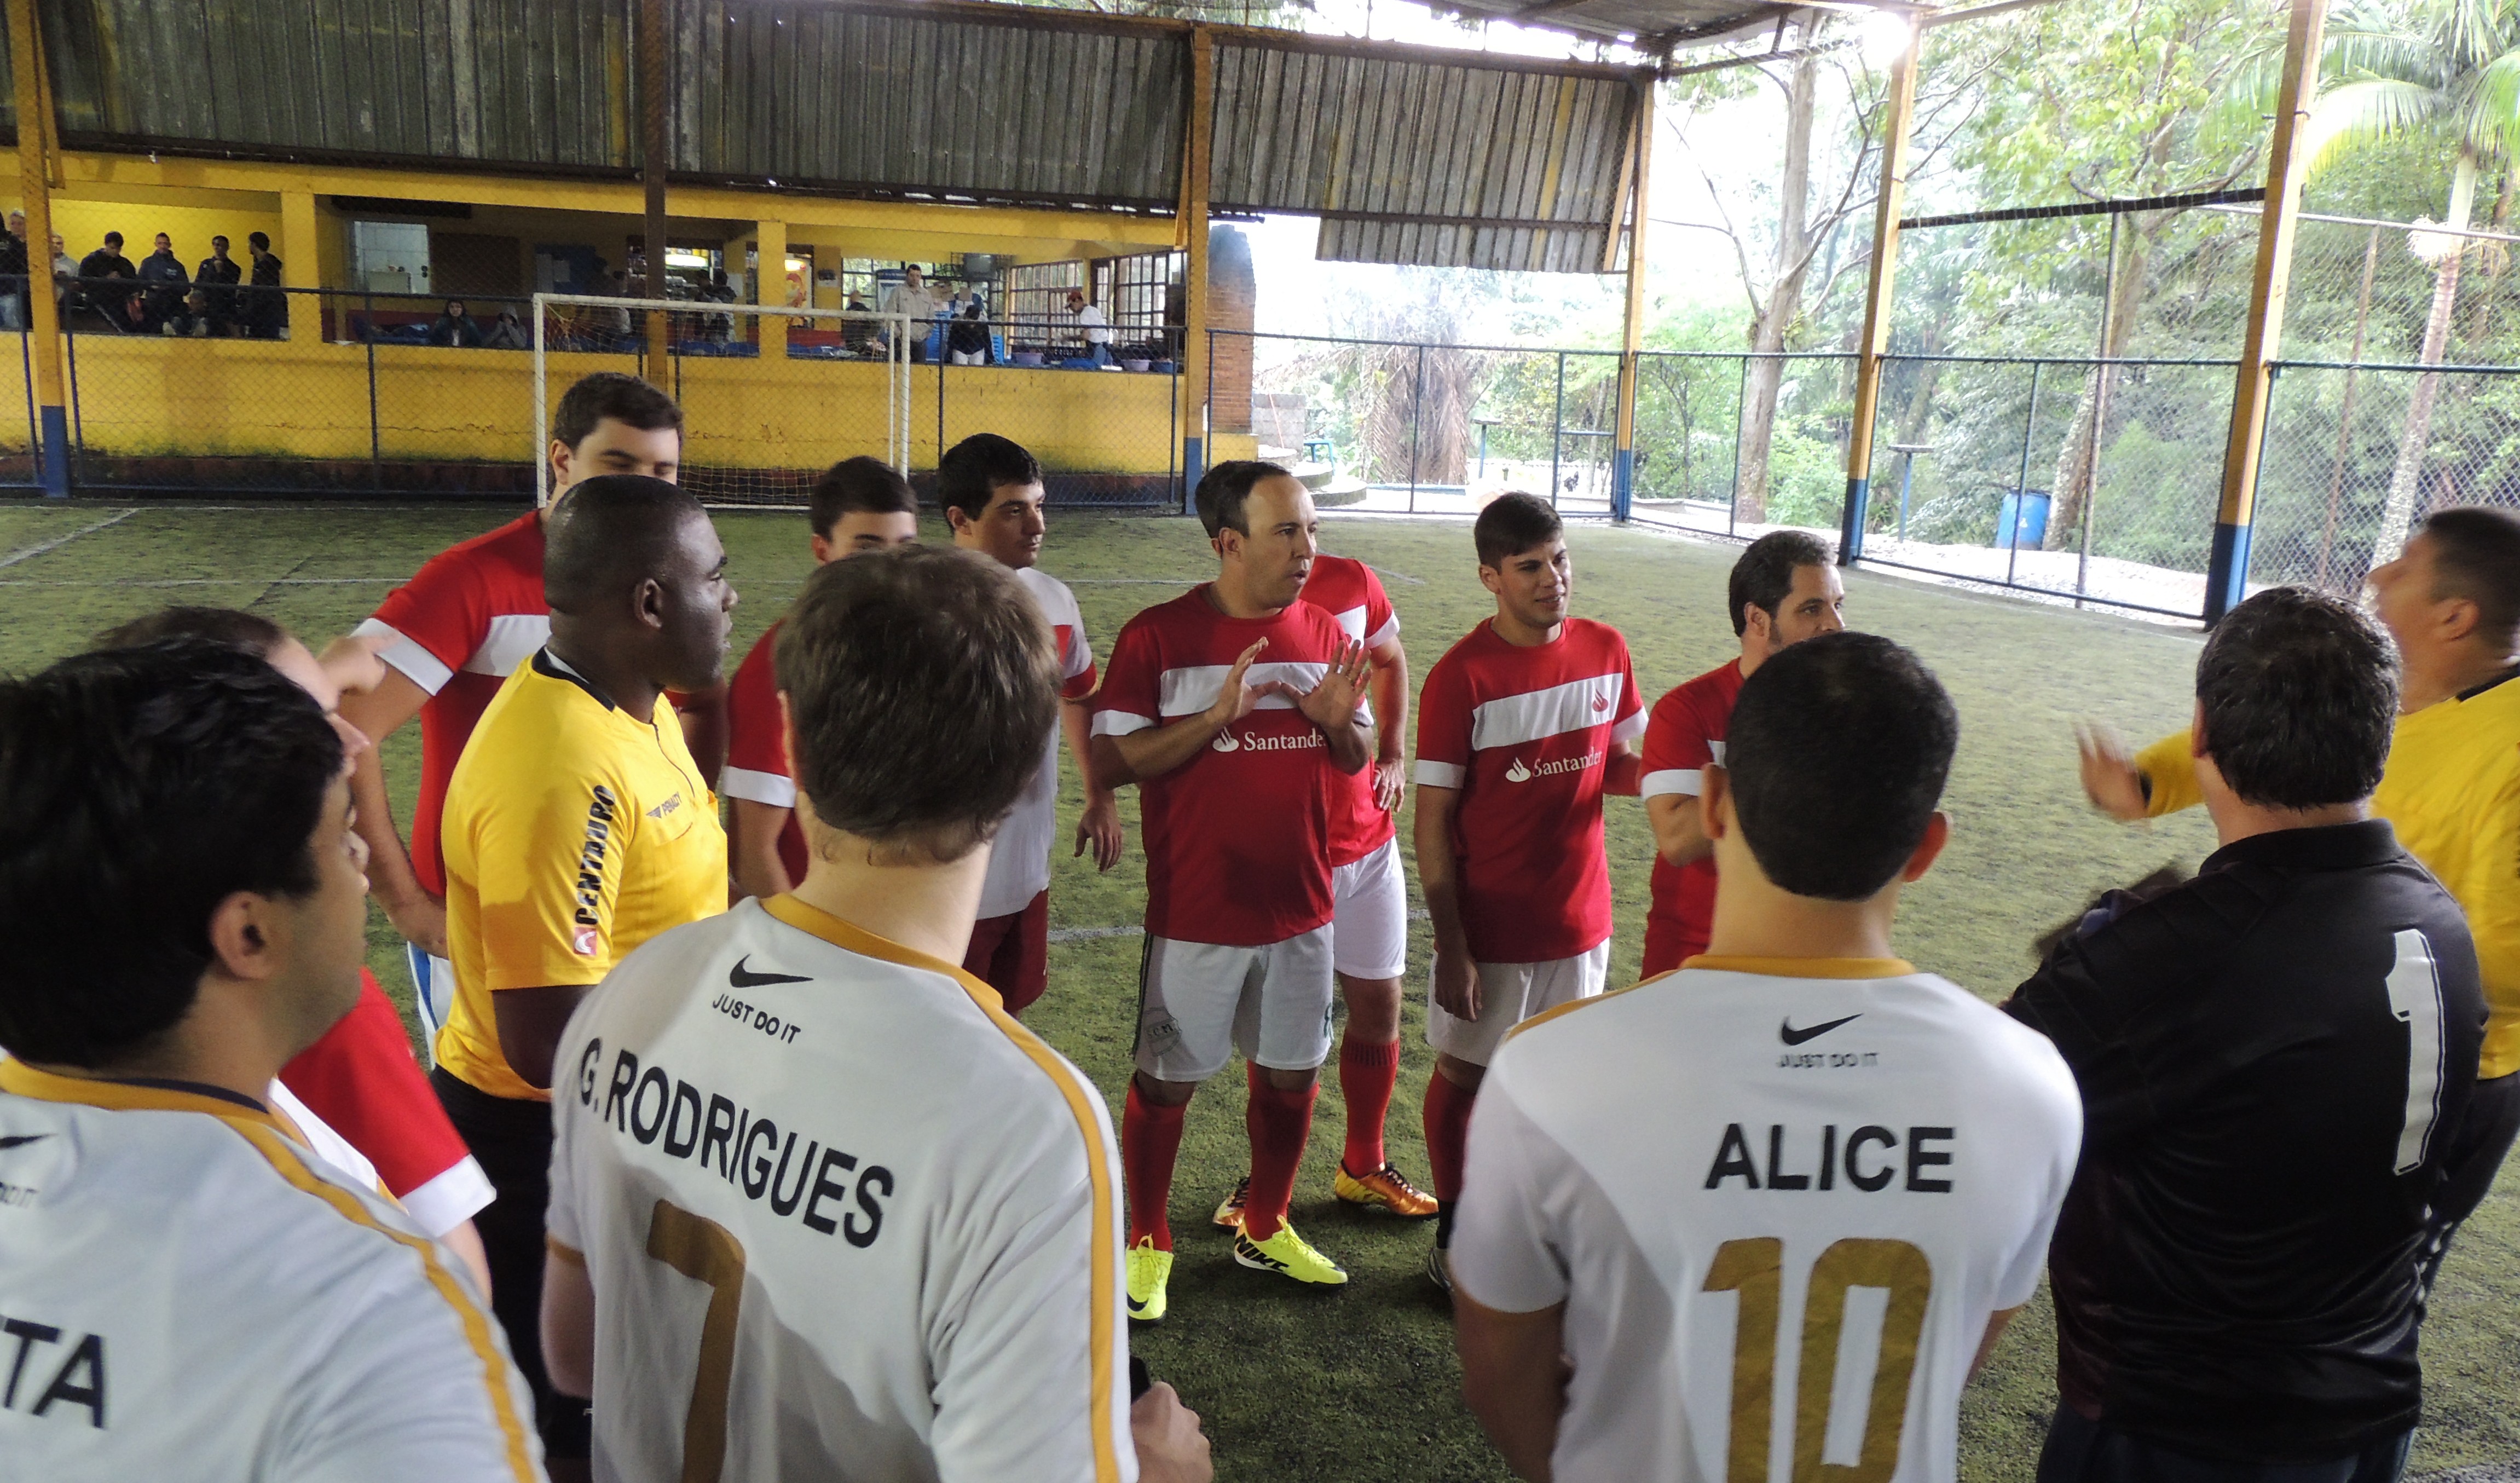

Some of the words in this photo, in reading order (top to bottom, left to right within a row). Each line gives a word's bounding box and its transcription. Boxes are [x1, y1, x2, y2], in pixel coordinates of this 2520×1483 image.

[1244, 728, 1326, 752] Santande
[1533, 746, 1602, 778] Santander
[661, 791, 682, 816] PENALTY
[574, 784, 616, 925] CENTAURO
[713, 993, 755, 1023] JUST
[754, 1011, 780, 1036] DO
[780, 1023, 801, 1044] IT
[1777, 1053, 1824, 1068] JUST
[1829, 1053, 1858, 1067] DO
[1862, 1052, 1880, 1067] IT
[2385, 929, 2446, 1176] 1
[1702, 1122, 1956, 1194] ALICE
[646, 1198, 747, 1483] 7
[1701, 1236, 1933, 1483] 10
